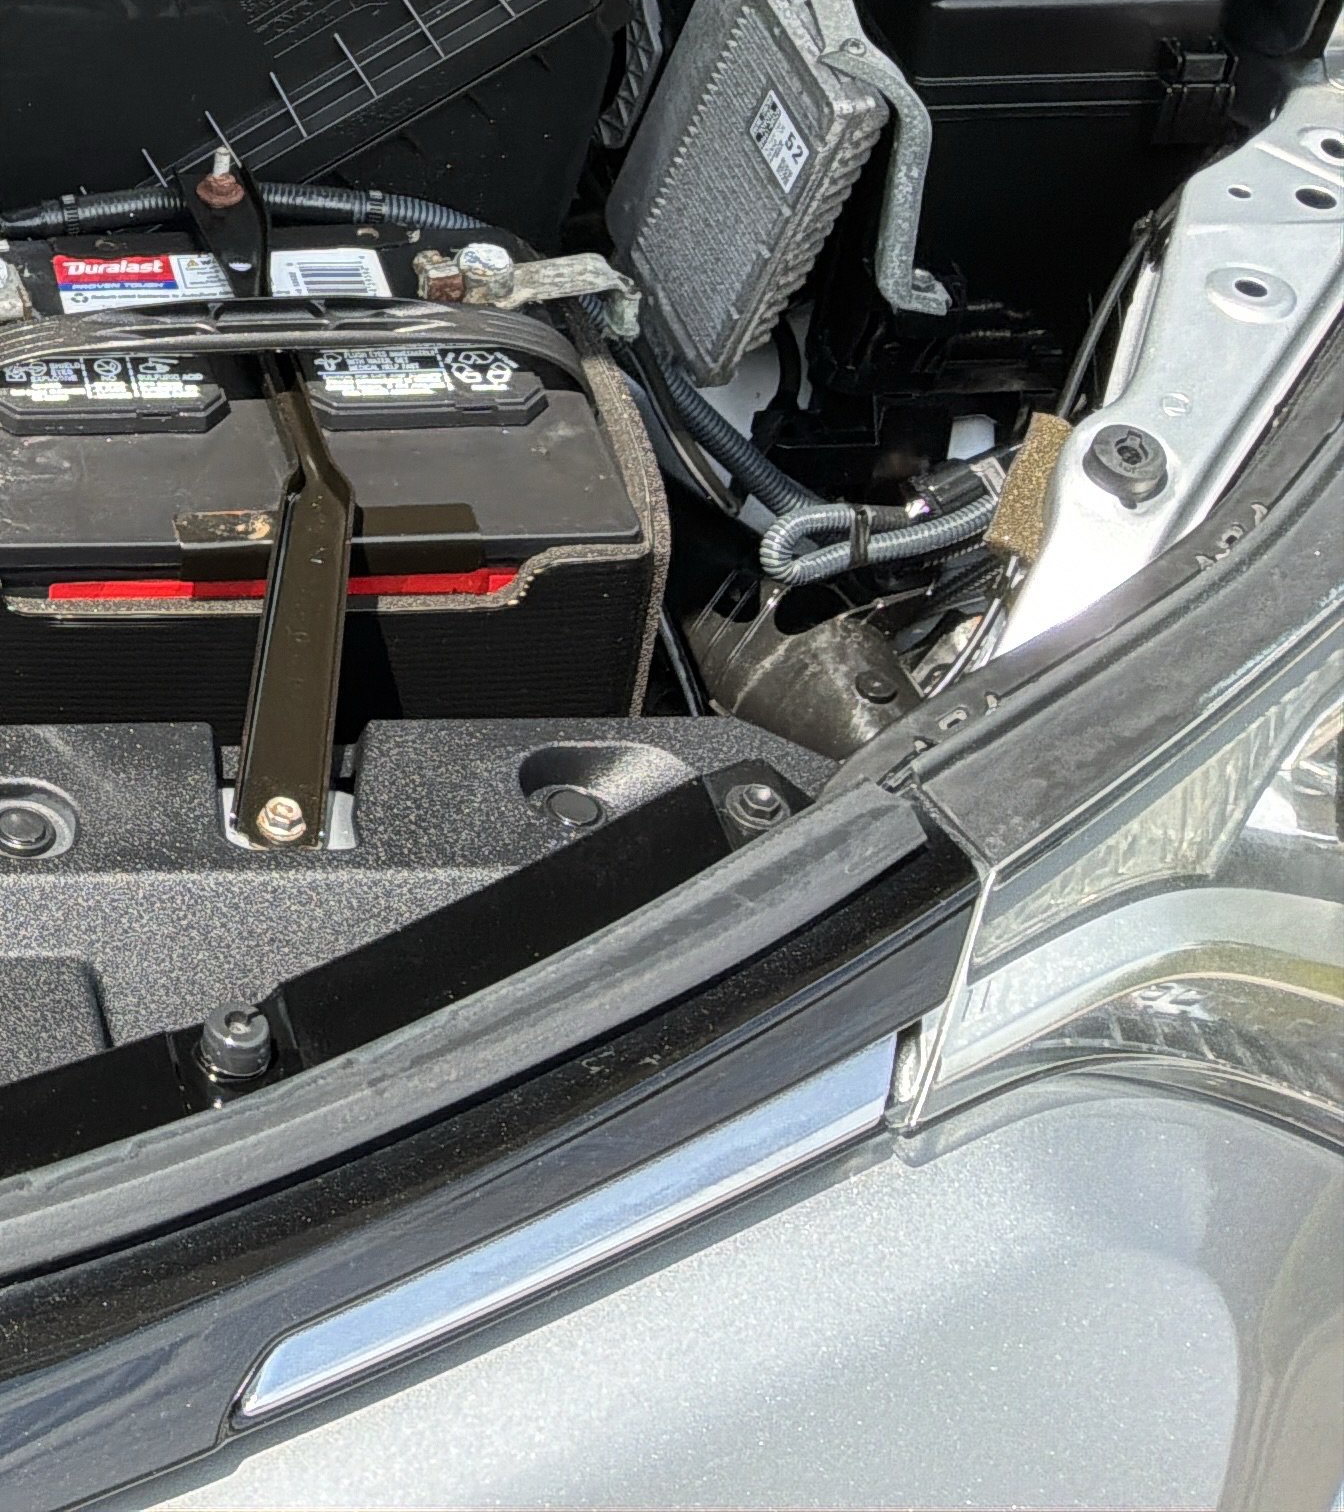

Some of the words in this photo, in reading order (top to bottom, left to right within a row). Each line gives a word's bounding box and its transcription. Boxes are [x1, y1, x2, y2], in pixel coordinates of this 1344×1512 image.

[784, 131, 804, 165] 52
[63, 259, 164, 276] Duralast
[72, 282, 121, 290] PROVEN
